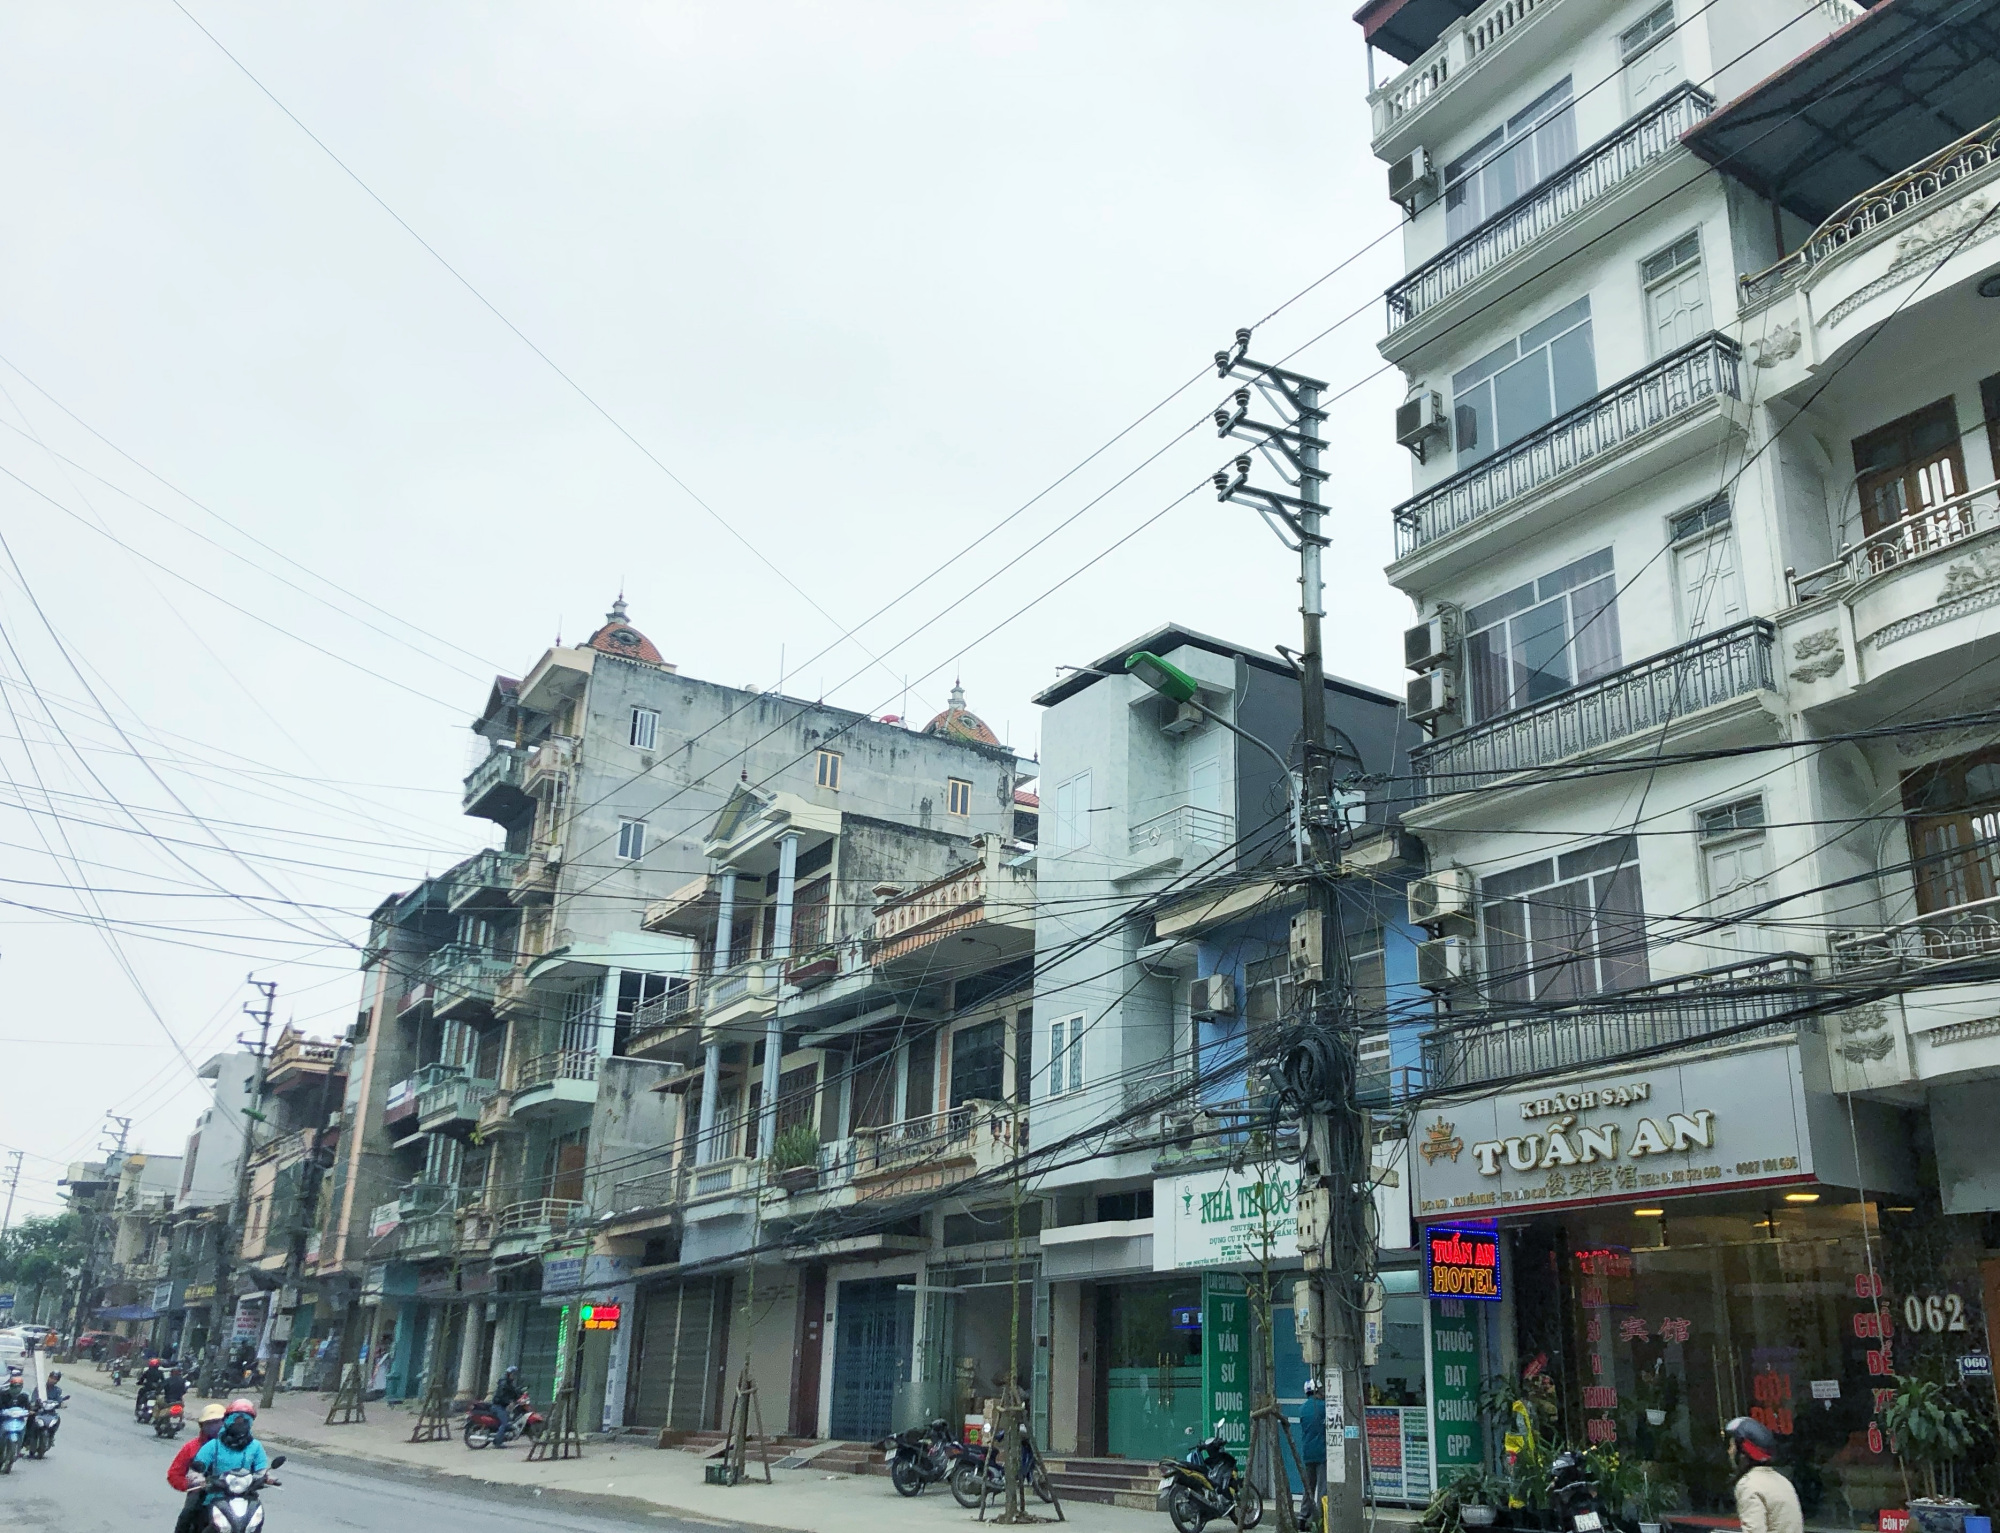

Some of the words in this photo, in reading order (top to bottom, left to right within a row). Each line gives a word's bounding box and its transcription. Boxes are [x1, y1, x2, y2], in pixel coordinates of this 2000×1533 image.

[1519, 1092, 1598, 1119] KHÁCH
[1601, 1082, 1651, 1107] SẠN
[1472, 1114, 1619, 1176] TUẤN
[1627, 1109, 1715, 1158] AN
[1201, 1180, 1234, 1224] NHÀ
[1238, 1166, 1292, 1218] THUỐC
[1432, 1232, 1473, 1264] TUẤN
[1475, 1243, 1496, 1266] AN
[1433, 1266, 1497, 1294] HOTEL
[1855, 1267, 1884, 1298] CÓ
[1853, 1301, 1894, 1338] CHỖ
[1904, 1294, 1968, 1333] 062
[1218, 1328, 1239, 1353] VẤN
[1436, 1324, 1473, 1352] THUỐC
[1620, 1316, 1692, 1343] 宾馆
[1221, 1356, 1236, 1383] SỬ
[1867, 1340, 1895, 1376] ĐỂ
[1963, 1357, 1987, 1368] 060
[1445, 1366, 1467, 1391] ĐẠT
[1215, 1391, 1243, 1416] DỤNG
[1582, 1386, 1618, 1408] TRUNG
[1213, 1416, 1246, 1442] THUỐC
[1587, 1411, 1617, 1442] QUỐC
[1448, 1434, 1471, 1457] GPP
[1882, 1514, 1898, 1531] CÒN
